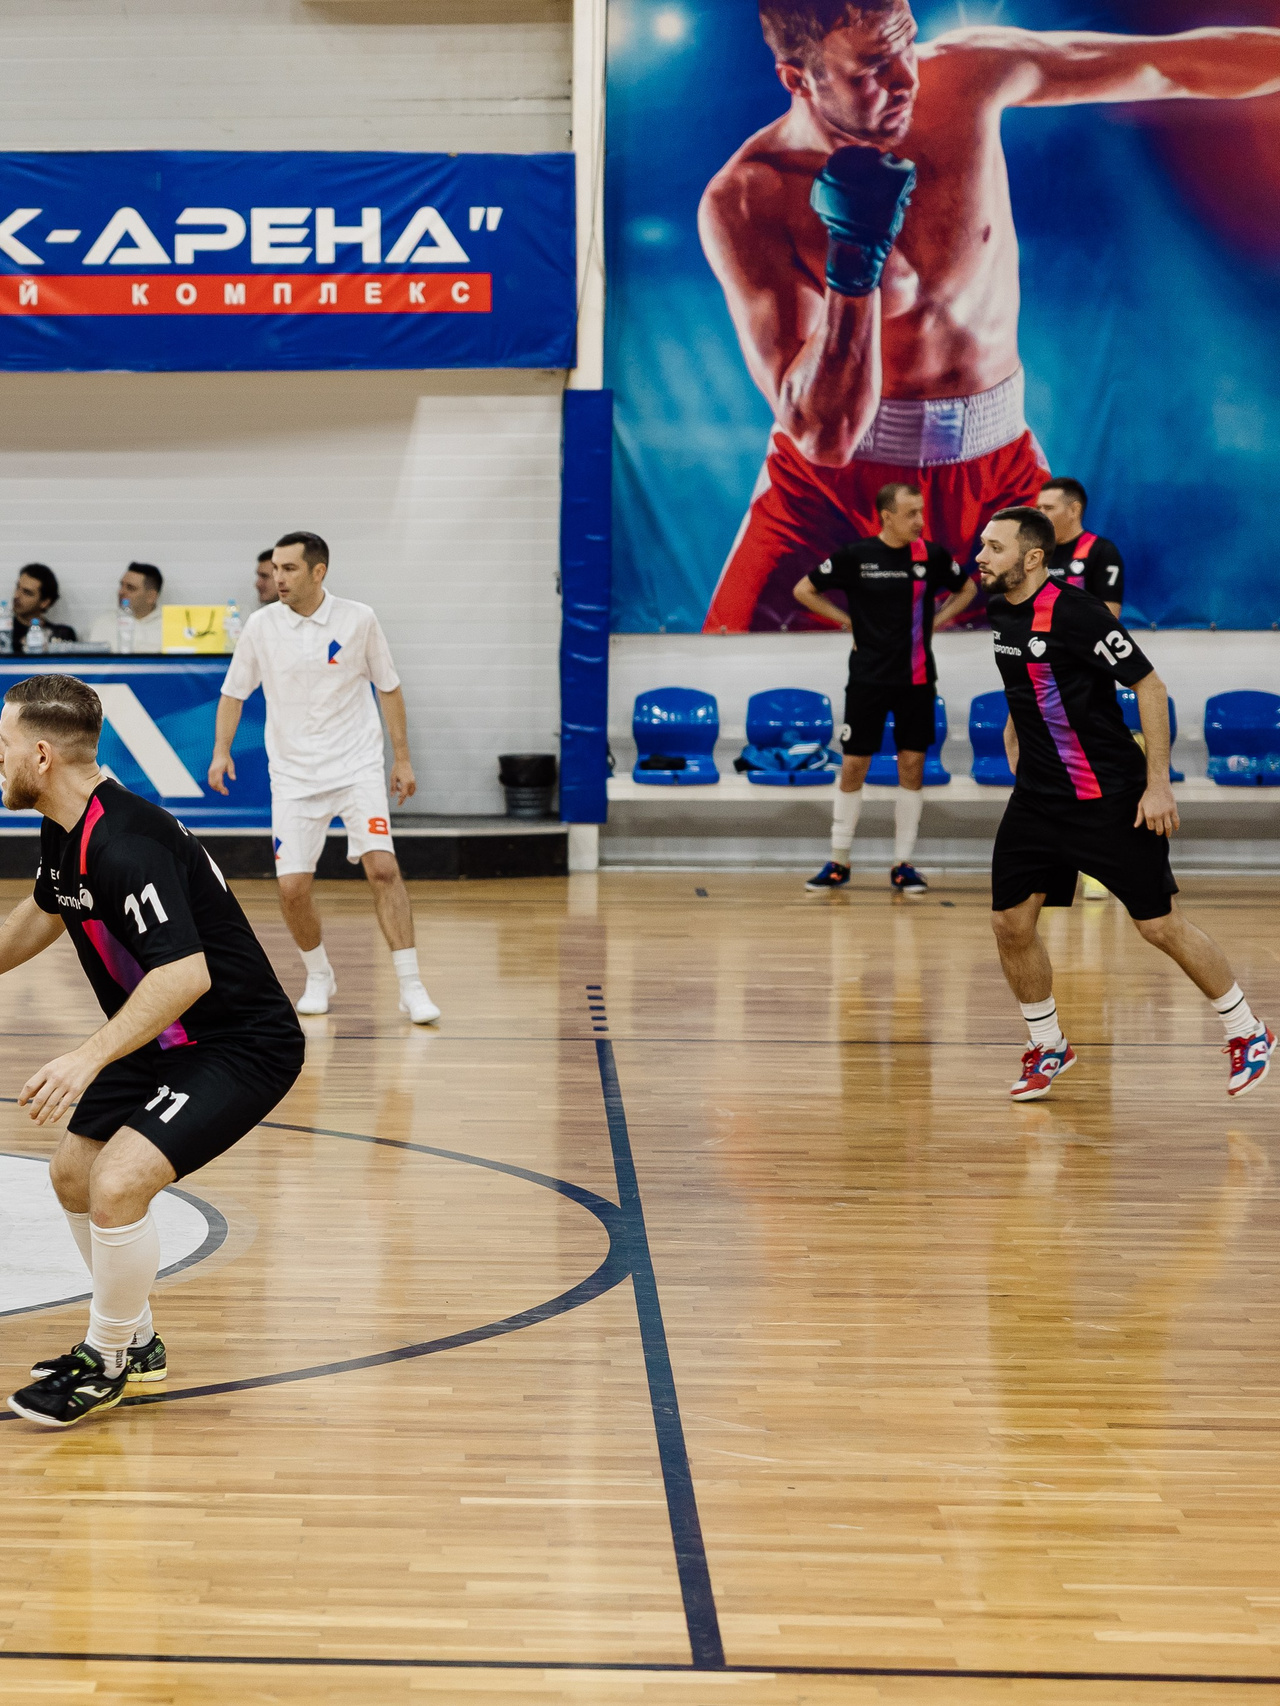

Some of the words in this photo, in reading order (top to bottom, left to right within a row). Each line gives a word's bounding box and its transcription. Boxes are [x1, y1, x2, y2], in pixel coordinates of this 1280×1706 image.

[131, 281, 470, 306] КОМПЛЕКС
[1105, 564, 1120, 587] 7
[1093, 629, 1133, 666] 13
[367, 817, 389, 836] 8
[124, 882, 169, 934] 11
[144, 1084, 190, 1124] 11
